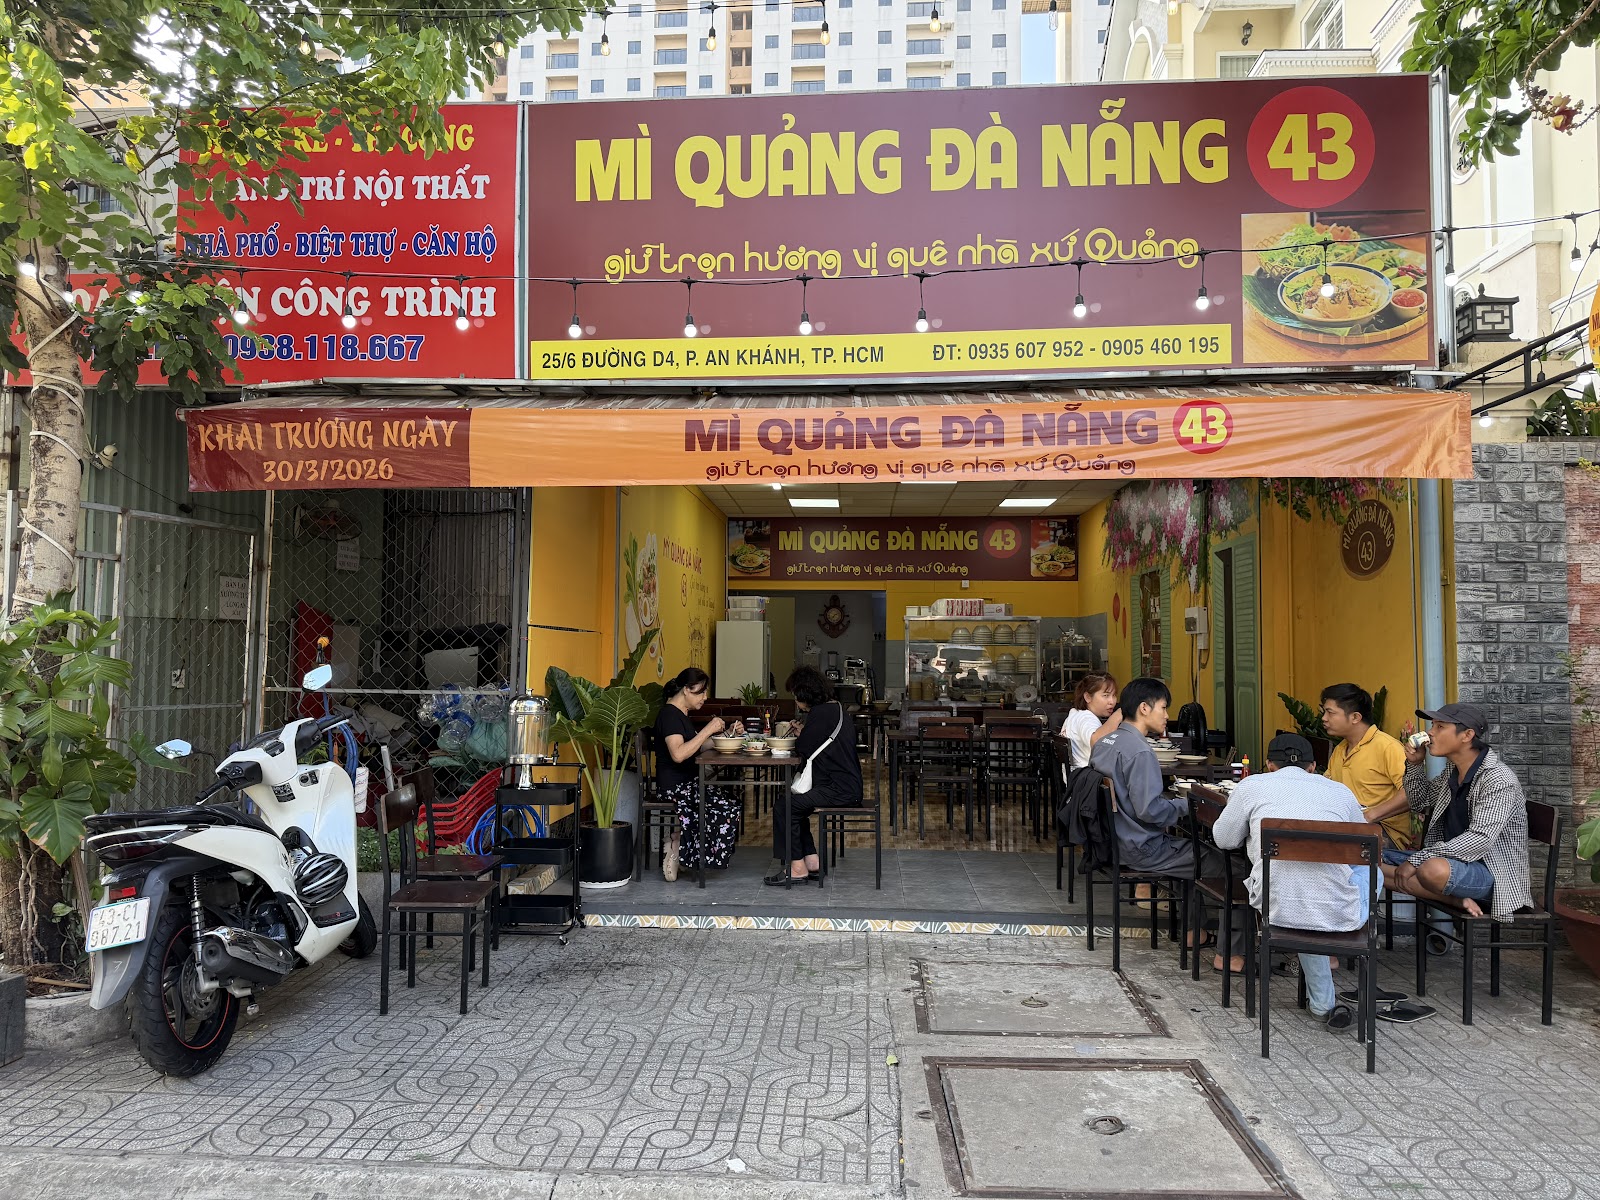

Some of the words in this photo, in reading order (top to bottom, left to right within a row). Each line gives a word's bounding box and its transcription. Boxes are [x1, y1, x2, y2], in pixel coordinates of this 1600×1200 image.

[575, 123, 652, 202] MÌ
[674, 113, 902, 209] QUẢNG
[925, 112, 1018, 192] ĐÀ
[1041, 97, 1229, 188] NẴNG
[1266, 112, 1356, 182] 43
[298, 169, 346, 201] TRÍ
[353, 168, 405, 207] NỘI
[411, 163, 491, 200] THẤT
[235, 221, 280, 258] PHỐ
[295, 225, 346, 264] BIỆT
[350, 227, 398, 264] THỰ
[412, 223, 460, 257] CĂN
[464, 224, 498, 264] HỘ
[604, 243, 660, 285] giữ
[658, 242, 735, 280] trọn
[744, 240, 842, 279] hương
[852, 241, 878, 277] vị
[887, 239, 947, 278] quê
[957, 233, 1019, 265] nhà
[1029, 227, 1081, 264] xứ
[1083, 226, 1199, 269] Quảng
[270, 277, 371, 317] CÔNG
[380, 277, 497, 317] TRÌNH
[222, 333, 426, 362] 0938.118.667
[542, 352, 576, 369] 25/6
[581, 346, 647, 369] ĐƯỜNG
[652, 350, 681, 370] D4,
[686, 350, 700, 367] P.
[705, 349, 730, 366] AN
[736, 344, 806, 368] KHÁNH,
[811, 347, 837, 365] TP.
[843, 345, 885, 364] HCM
[932, 343, 961, 361] ĐT:
[968, 342, 1010, 361] 0935
[1015, 341, 1047, 359] 607
[1052, 340, 1084, 358] 952
[1102, 338, 1144, 357] 0905
[1150, 337, 1182, 355] 460
[1188, 336, 1220, 354] 195
[198, 422, 263, 452] KHAI
[270, 416, 374, 451] TRƯƠNG
[382, 415, 459, 450] NGÀY
[684, 413, 741, 452] MÌ
[757, 410, 921, 456] QUẢNG
[938, 409, 1005, 449] ĐÀ
[1022, 403, 1159, 447] NẴNG
[1178, 407, 1228, 445] 43
[262, 457, 395, 483] 30/3/2026
[706, 460, 747, 482] giữ
[746, 459, 801, 479] trọn
[807, 458, 879, 480] hương
[886, 460, 905, 479] vị
[911, 459, 955, 479] quê
[1013, 453, 1050, 473] xứ
[1052, 453, 1136, 476] Quảng
[778, 527, 803, 551] MÌ
[809, 525, 880, 554] QUẢNG
[886, 526, 915, 551] ĐÀ
[921, 522, 979, 551] NẴNG
[989, 529, 1016, 551] 43
[1360, 540, 1373, 562] 43
[830, 563, 861, 576] hương
[933, 561, 969, 577] Quảng
[91, 921, 141, 946] 987.21
